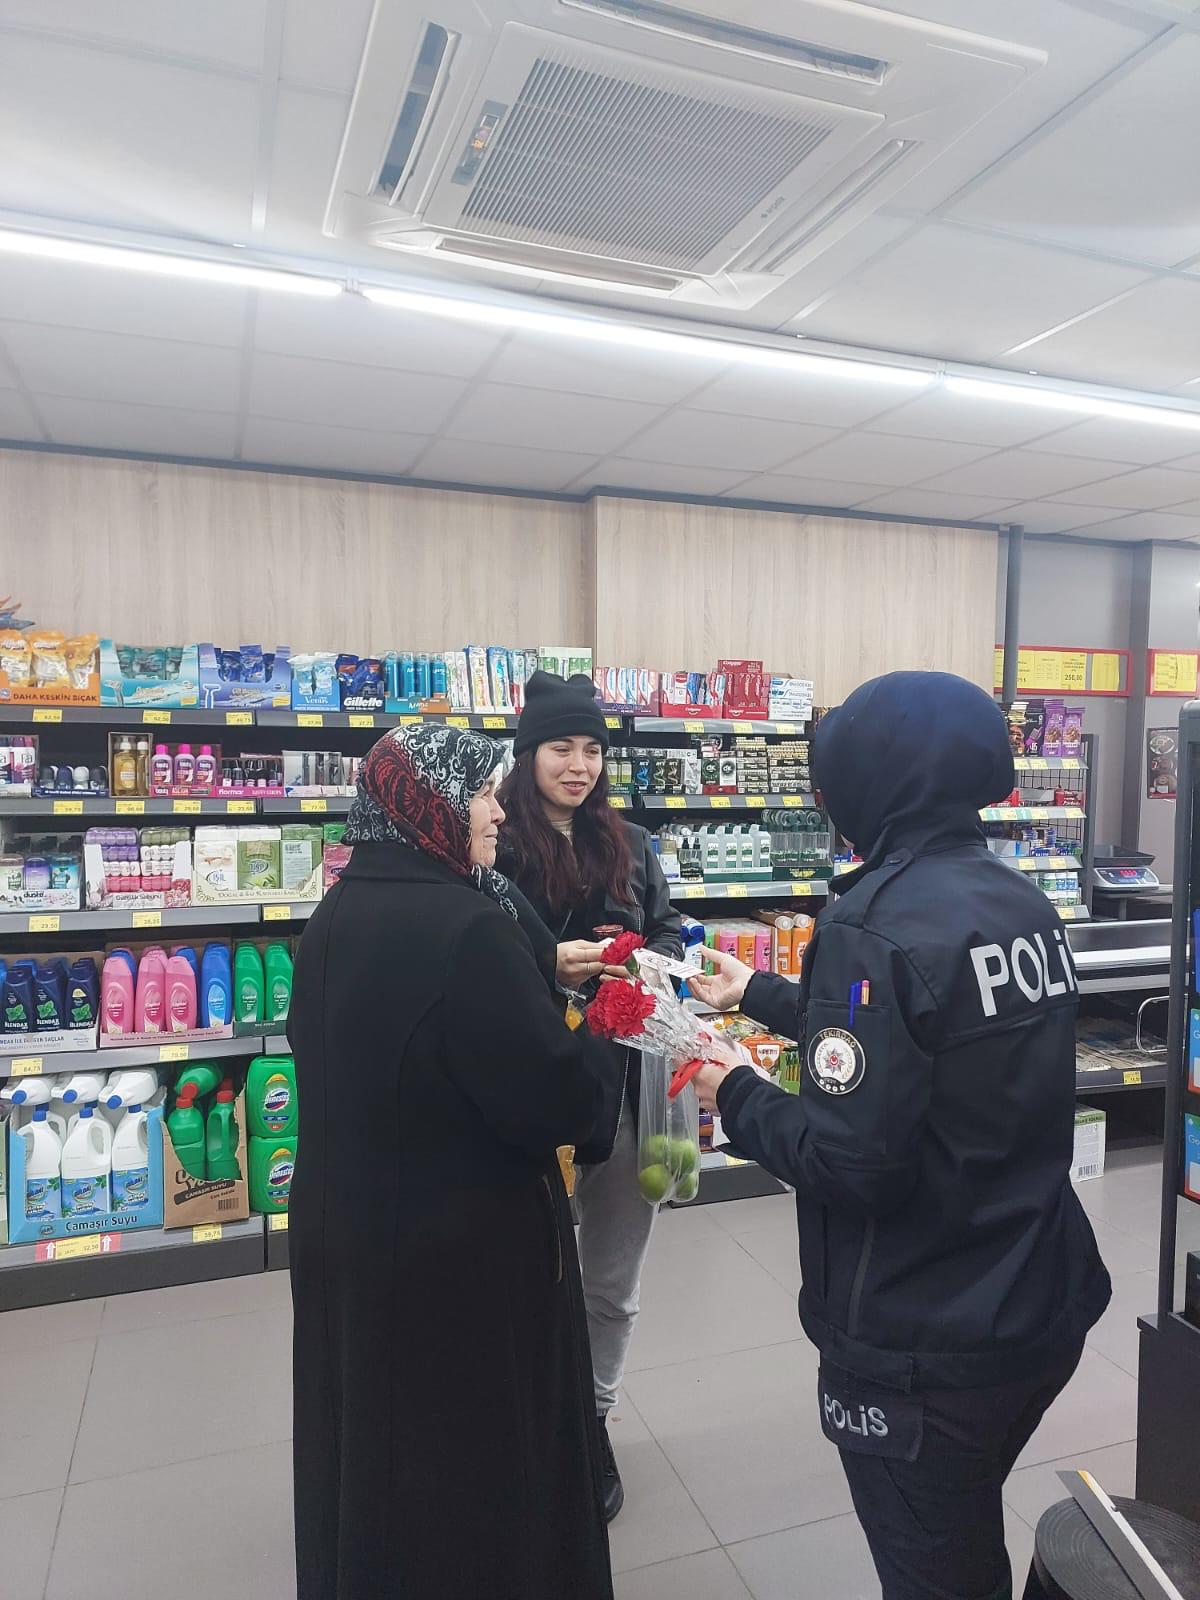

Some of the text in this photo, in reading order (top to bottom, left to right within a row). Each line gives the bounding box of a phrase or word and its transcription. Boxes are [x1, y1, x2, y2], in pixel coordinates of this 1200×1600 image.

[13, 693, 36, 701] DAHA
[343, 696, 383, 708] Gillette
[65, 1217, 109, 1233] Çamaşır
[111, 1214, 138, 1227] Suyu
